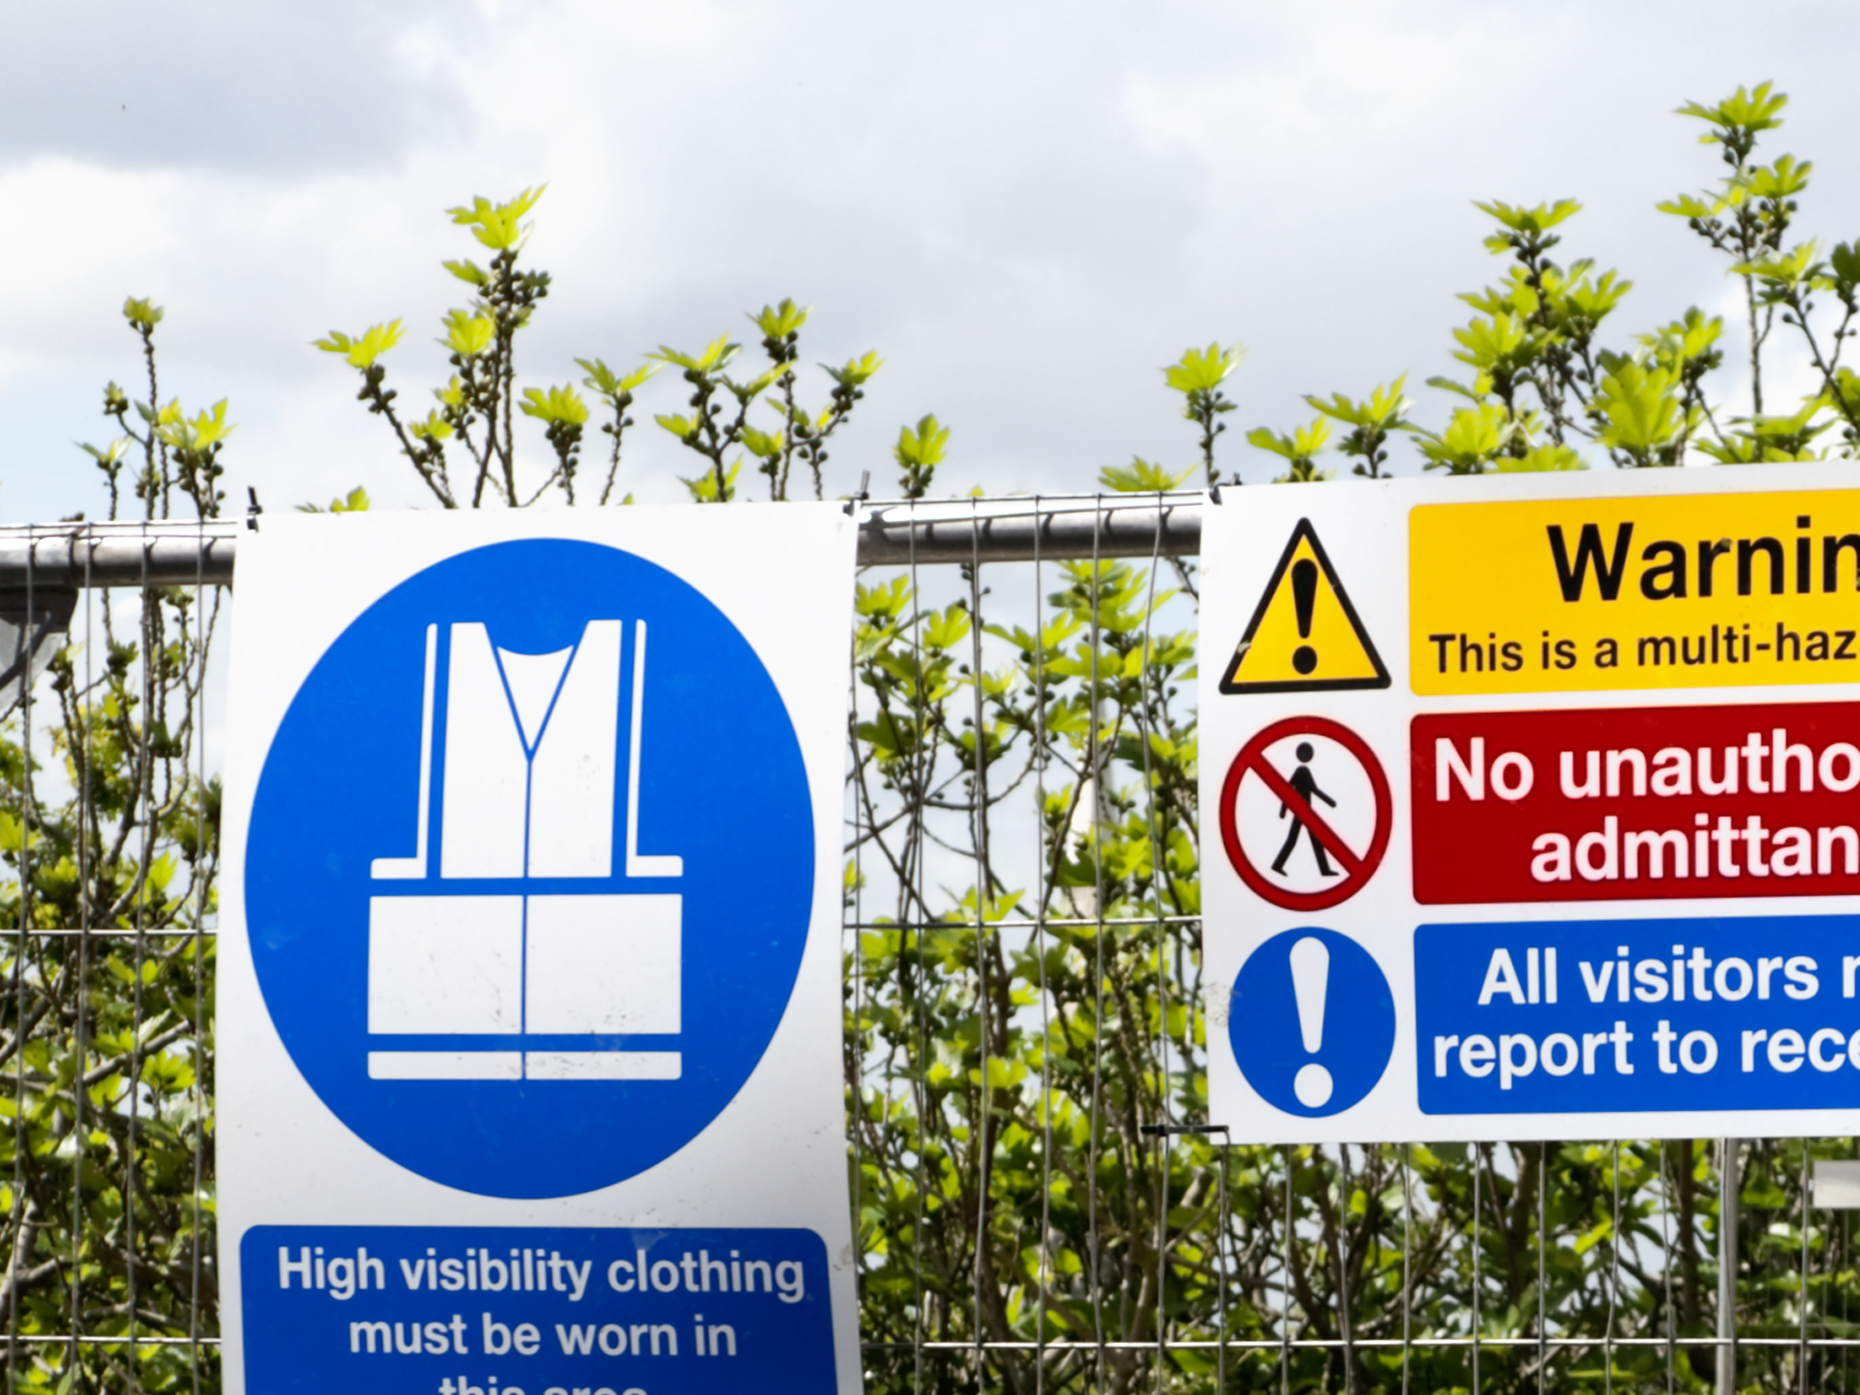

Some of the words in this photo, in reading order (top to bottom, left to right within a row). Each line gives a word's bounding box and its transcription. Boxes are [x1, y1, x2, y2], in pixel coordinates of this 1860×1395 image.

[1429, 633, 1523, 673] This
[1541, 630, 1577, 671] is
[1594, 638, 1618, 668] a
[1435, 736, 1534, 802] No
[1477, 946, 1558, 1006] All
[1578, 944, 1820, 1003] visitors
[1434, 1024, 1635, 1090] report
[1651, 1019, 1719, 1075] to
[278, 1246, 385, 1301] High
[399, 1247, 592, 1302] visibility
[607, 1248, 804, 1303] clothing
[349, 1314, 469, 1355] must
[482, 1312, 541, 1356] be
[555, 1323, 678, 1356] worn
[694, 1314, 736, 1356] in
